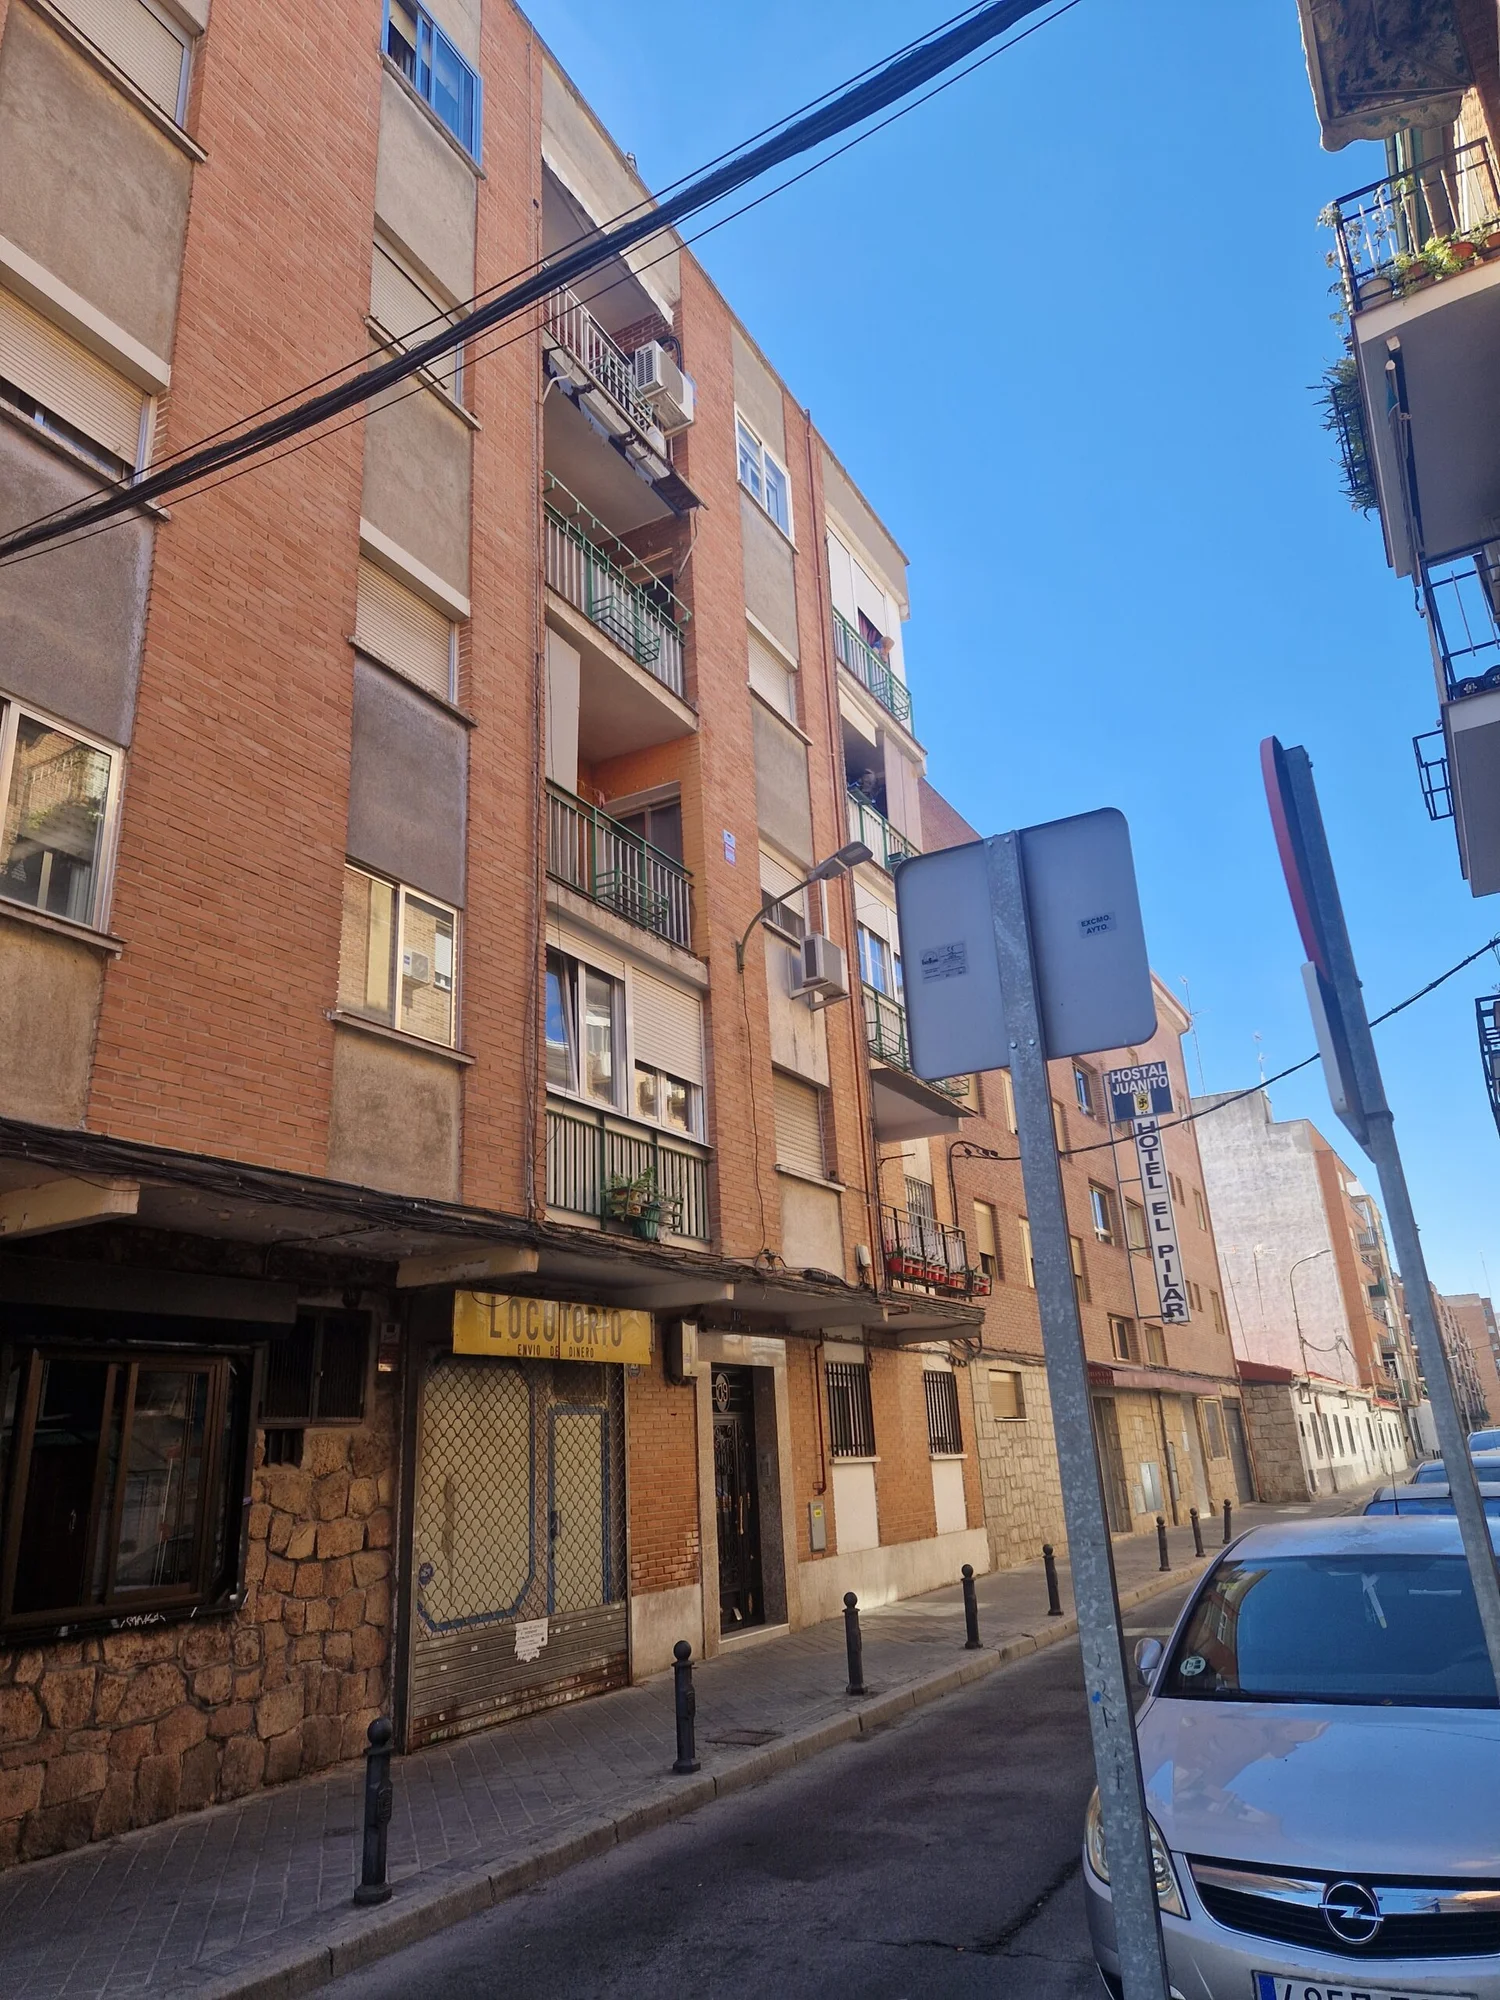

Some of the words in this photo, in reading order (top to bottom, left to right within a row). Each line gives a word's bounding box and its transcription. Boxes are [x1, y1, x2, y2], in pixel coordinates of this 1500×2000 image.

[1081, 914, 1111, 927] EXCMO.
[1110, 1063, 1167, 1083] HOSTAL
[1112, 1075, 1168, 1096] JUANITO
[1137, 1121, 1163, 1190] HOTEL
[1151, 1200, 1171, 1232] EL
[1158, 1244, 1185, 1317] PILAR
[489, 1296, 622, 1347] LOCUTORIO
[517, 1343, 541, 1357] ENVIO
[550, 1344, 560, 1357] DE
[568, 1346, 594, 1358] DINERO
